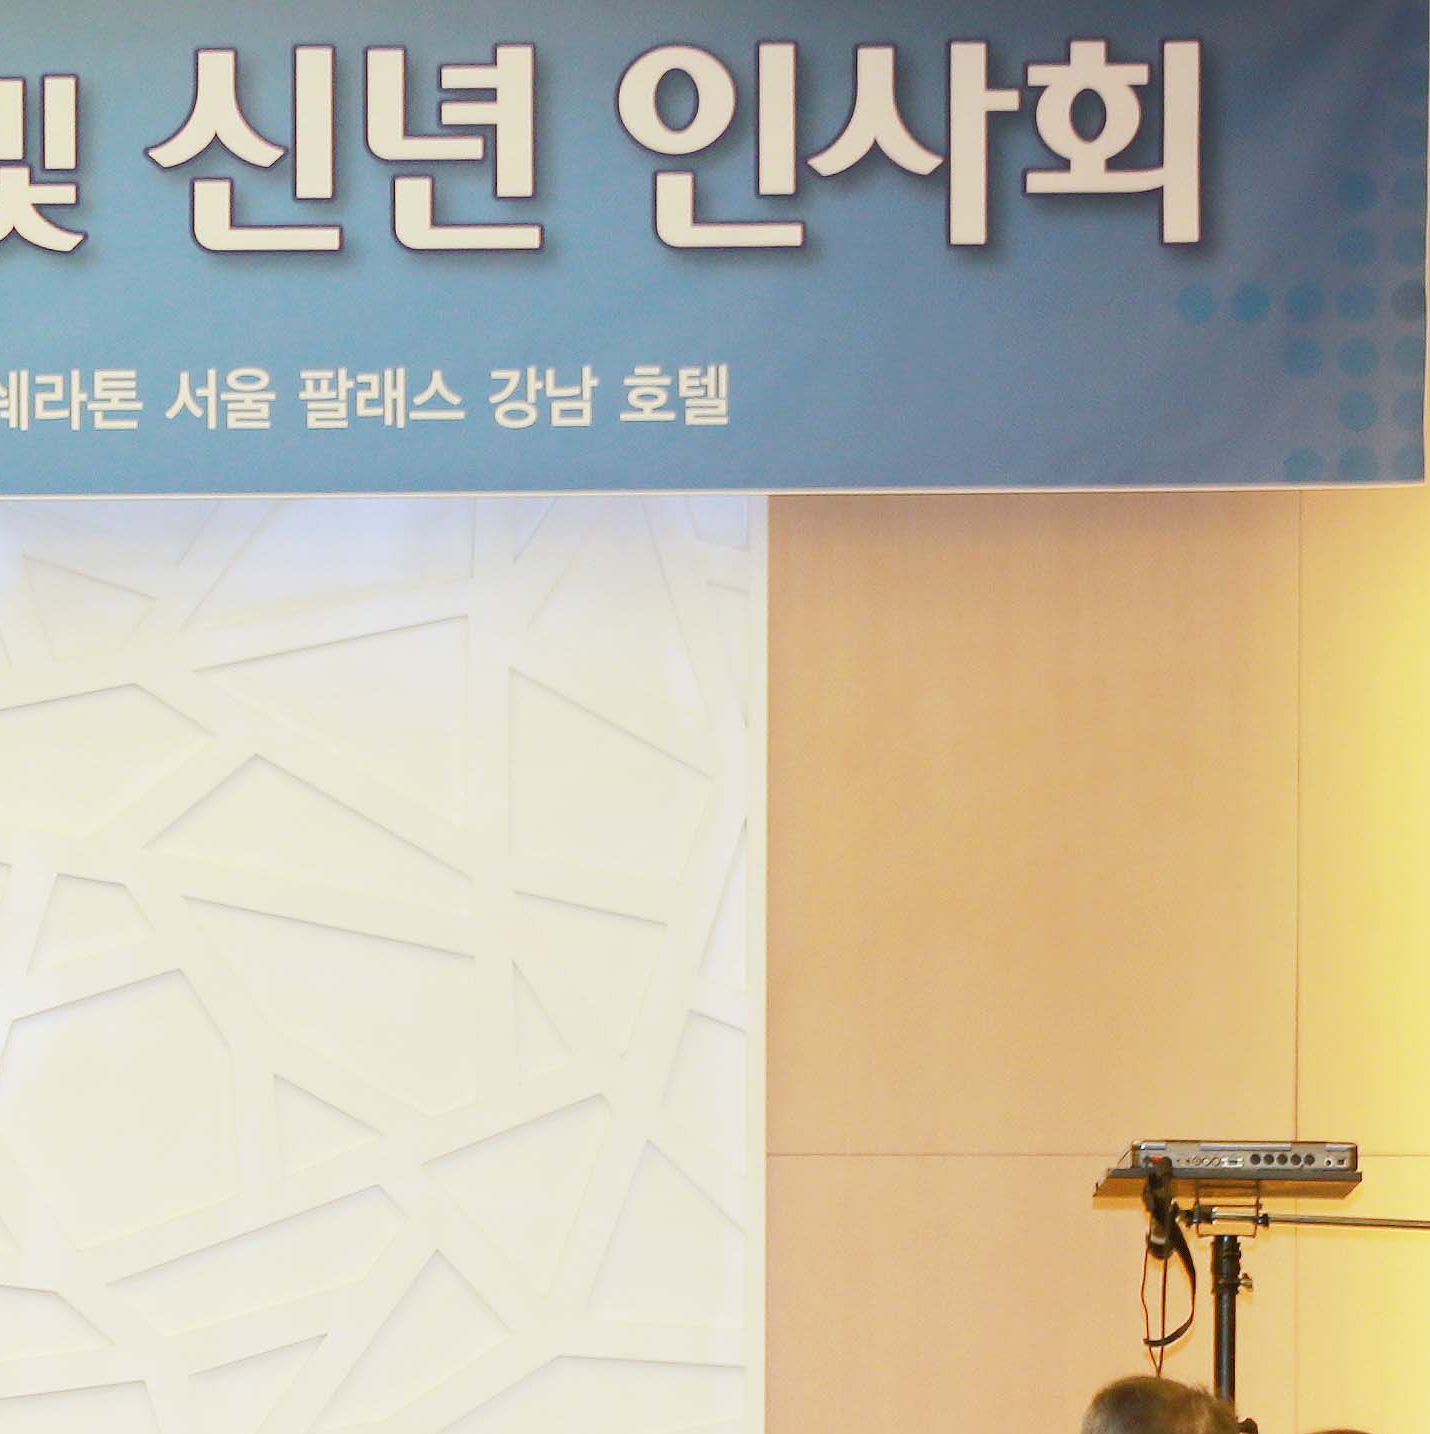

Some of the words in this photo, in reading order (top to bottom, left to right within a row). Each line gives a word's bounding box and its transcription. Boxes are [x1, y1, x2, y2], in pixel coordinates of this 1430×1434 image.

[146, 45, 542, 253] 신년
[616, 44, 1200, 249] 인사회
[164, 368, 277, 429] 서울
[298, 367, 465, 429] 팔래스
[488, 366, 600, 428] 강남
[619, 364, 729, 426] 호텔
